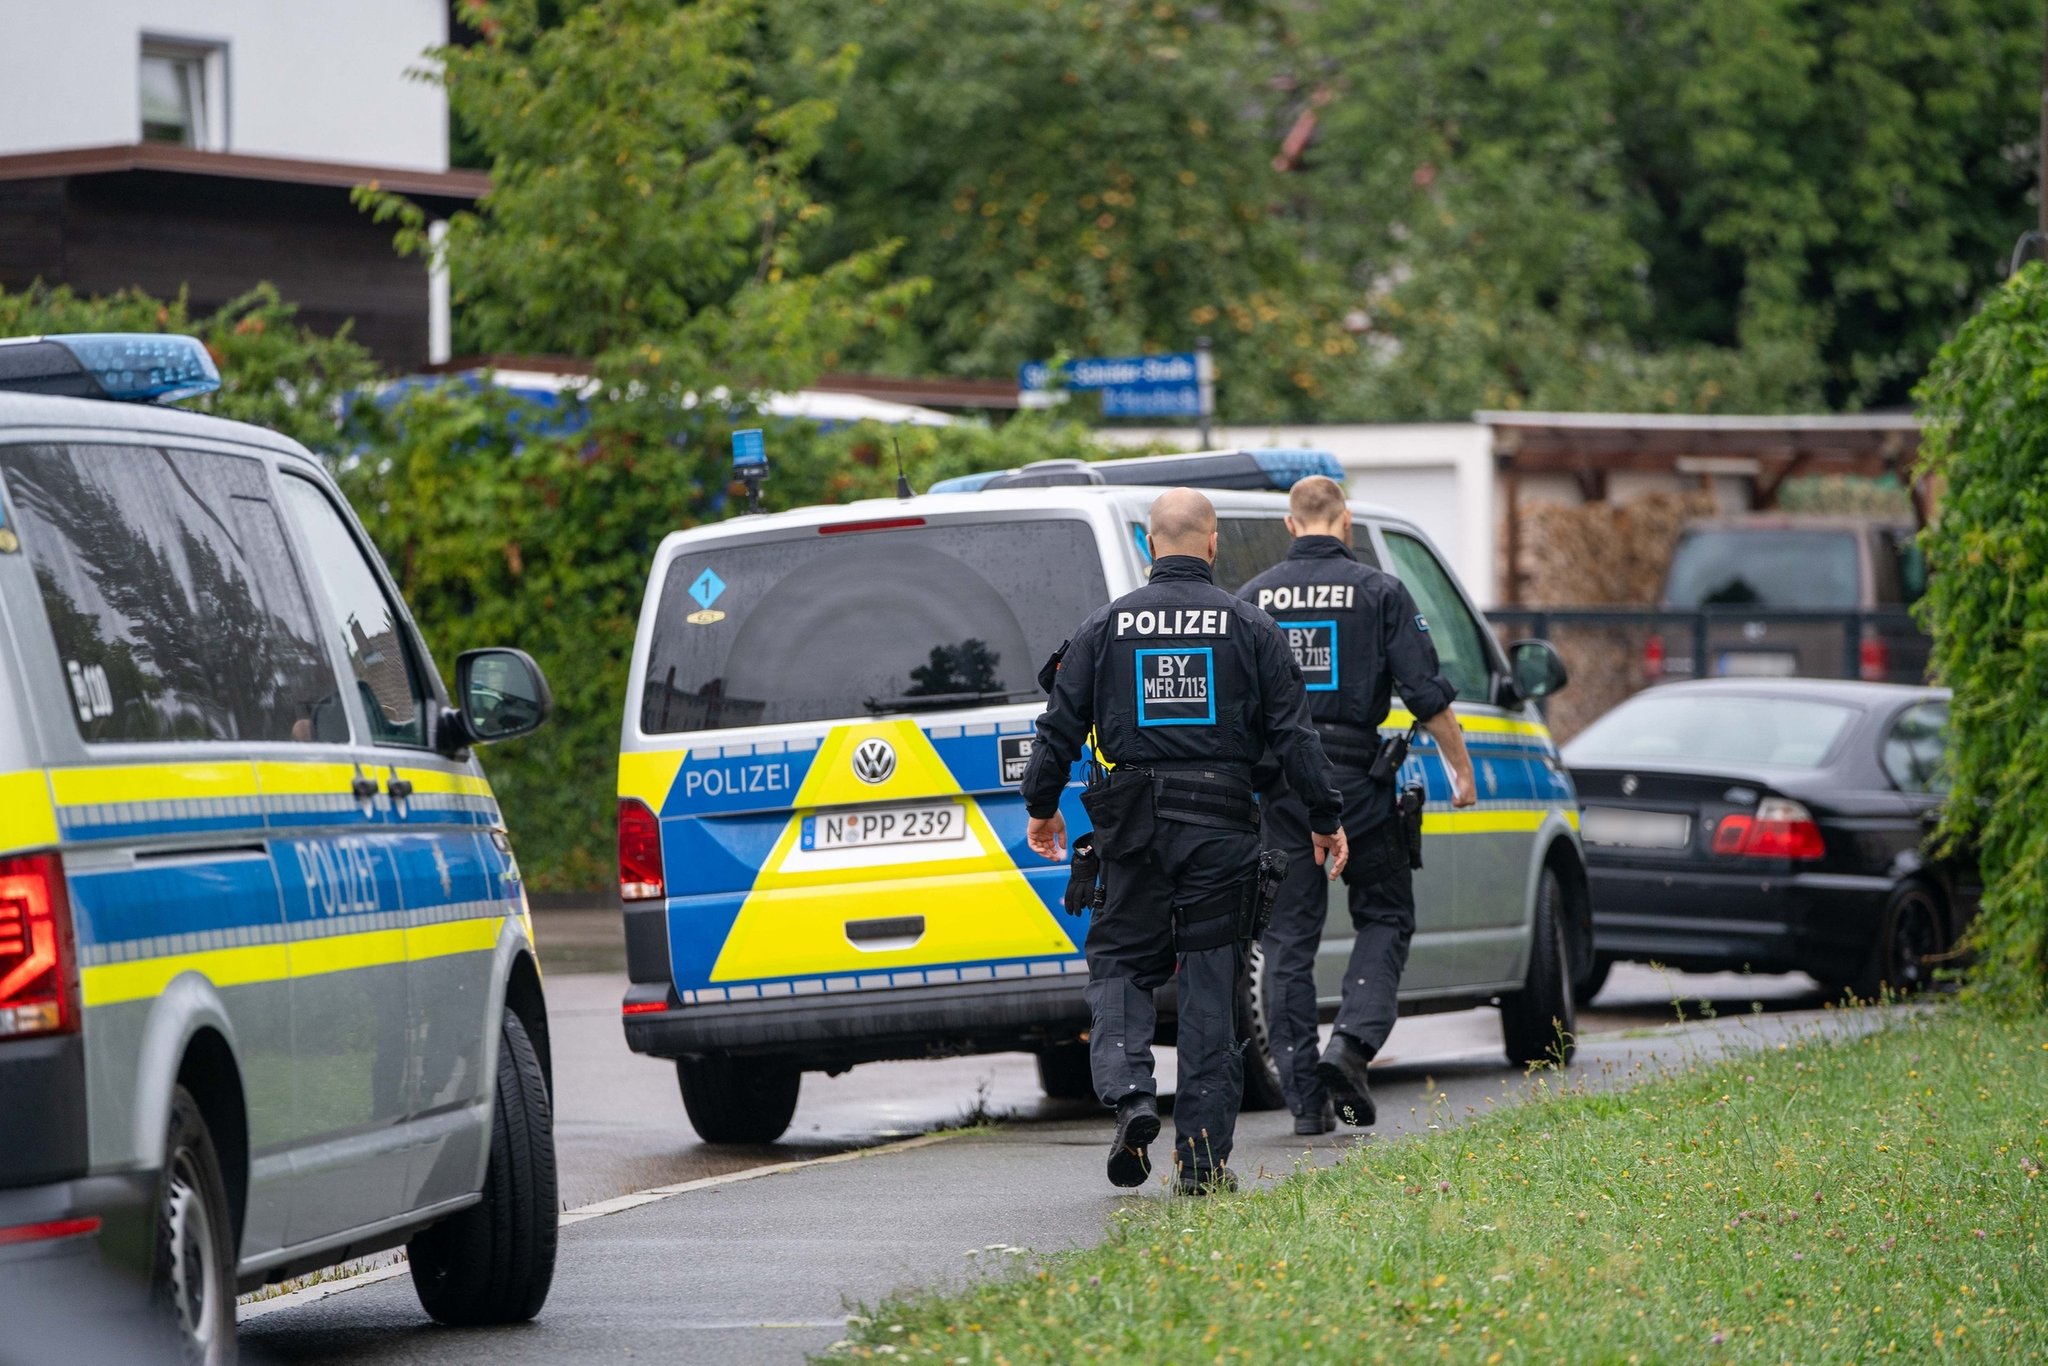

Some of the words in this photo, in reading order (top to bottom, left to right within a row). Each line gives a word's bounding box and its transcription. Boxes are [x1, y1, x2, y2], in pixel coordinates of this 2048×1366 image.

[701, 577, 711, 599] 1
[1259, 585, 1355, 610] POLIZEI
[1117, 610, 1228, 636] POLIZEI
[1288, 628, 1317, 648] BY
[1158, 655, 1191, 677] BY
[1304, 646, 1331, 666] 7113
[1144, 677, 1174, 698] MFR
[1177, 676, 1207, 698] 7113
[685, 763, 790, 797] POLIZEI
[826, 817, 843, 843] N
[862, 813, 896, 839] PP
[902, 810, 952, 837] 239
[294, 839, 380, 918] POLIZEI
